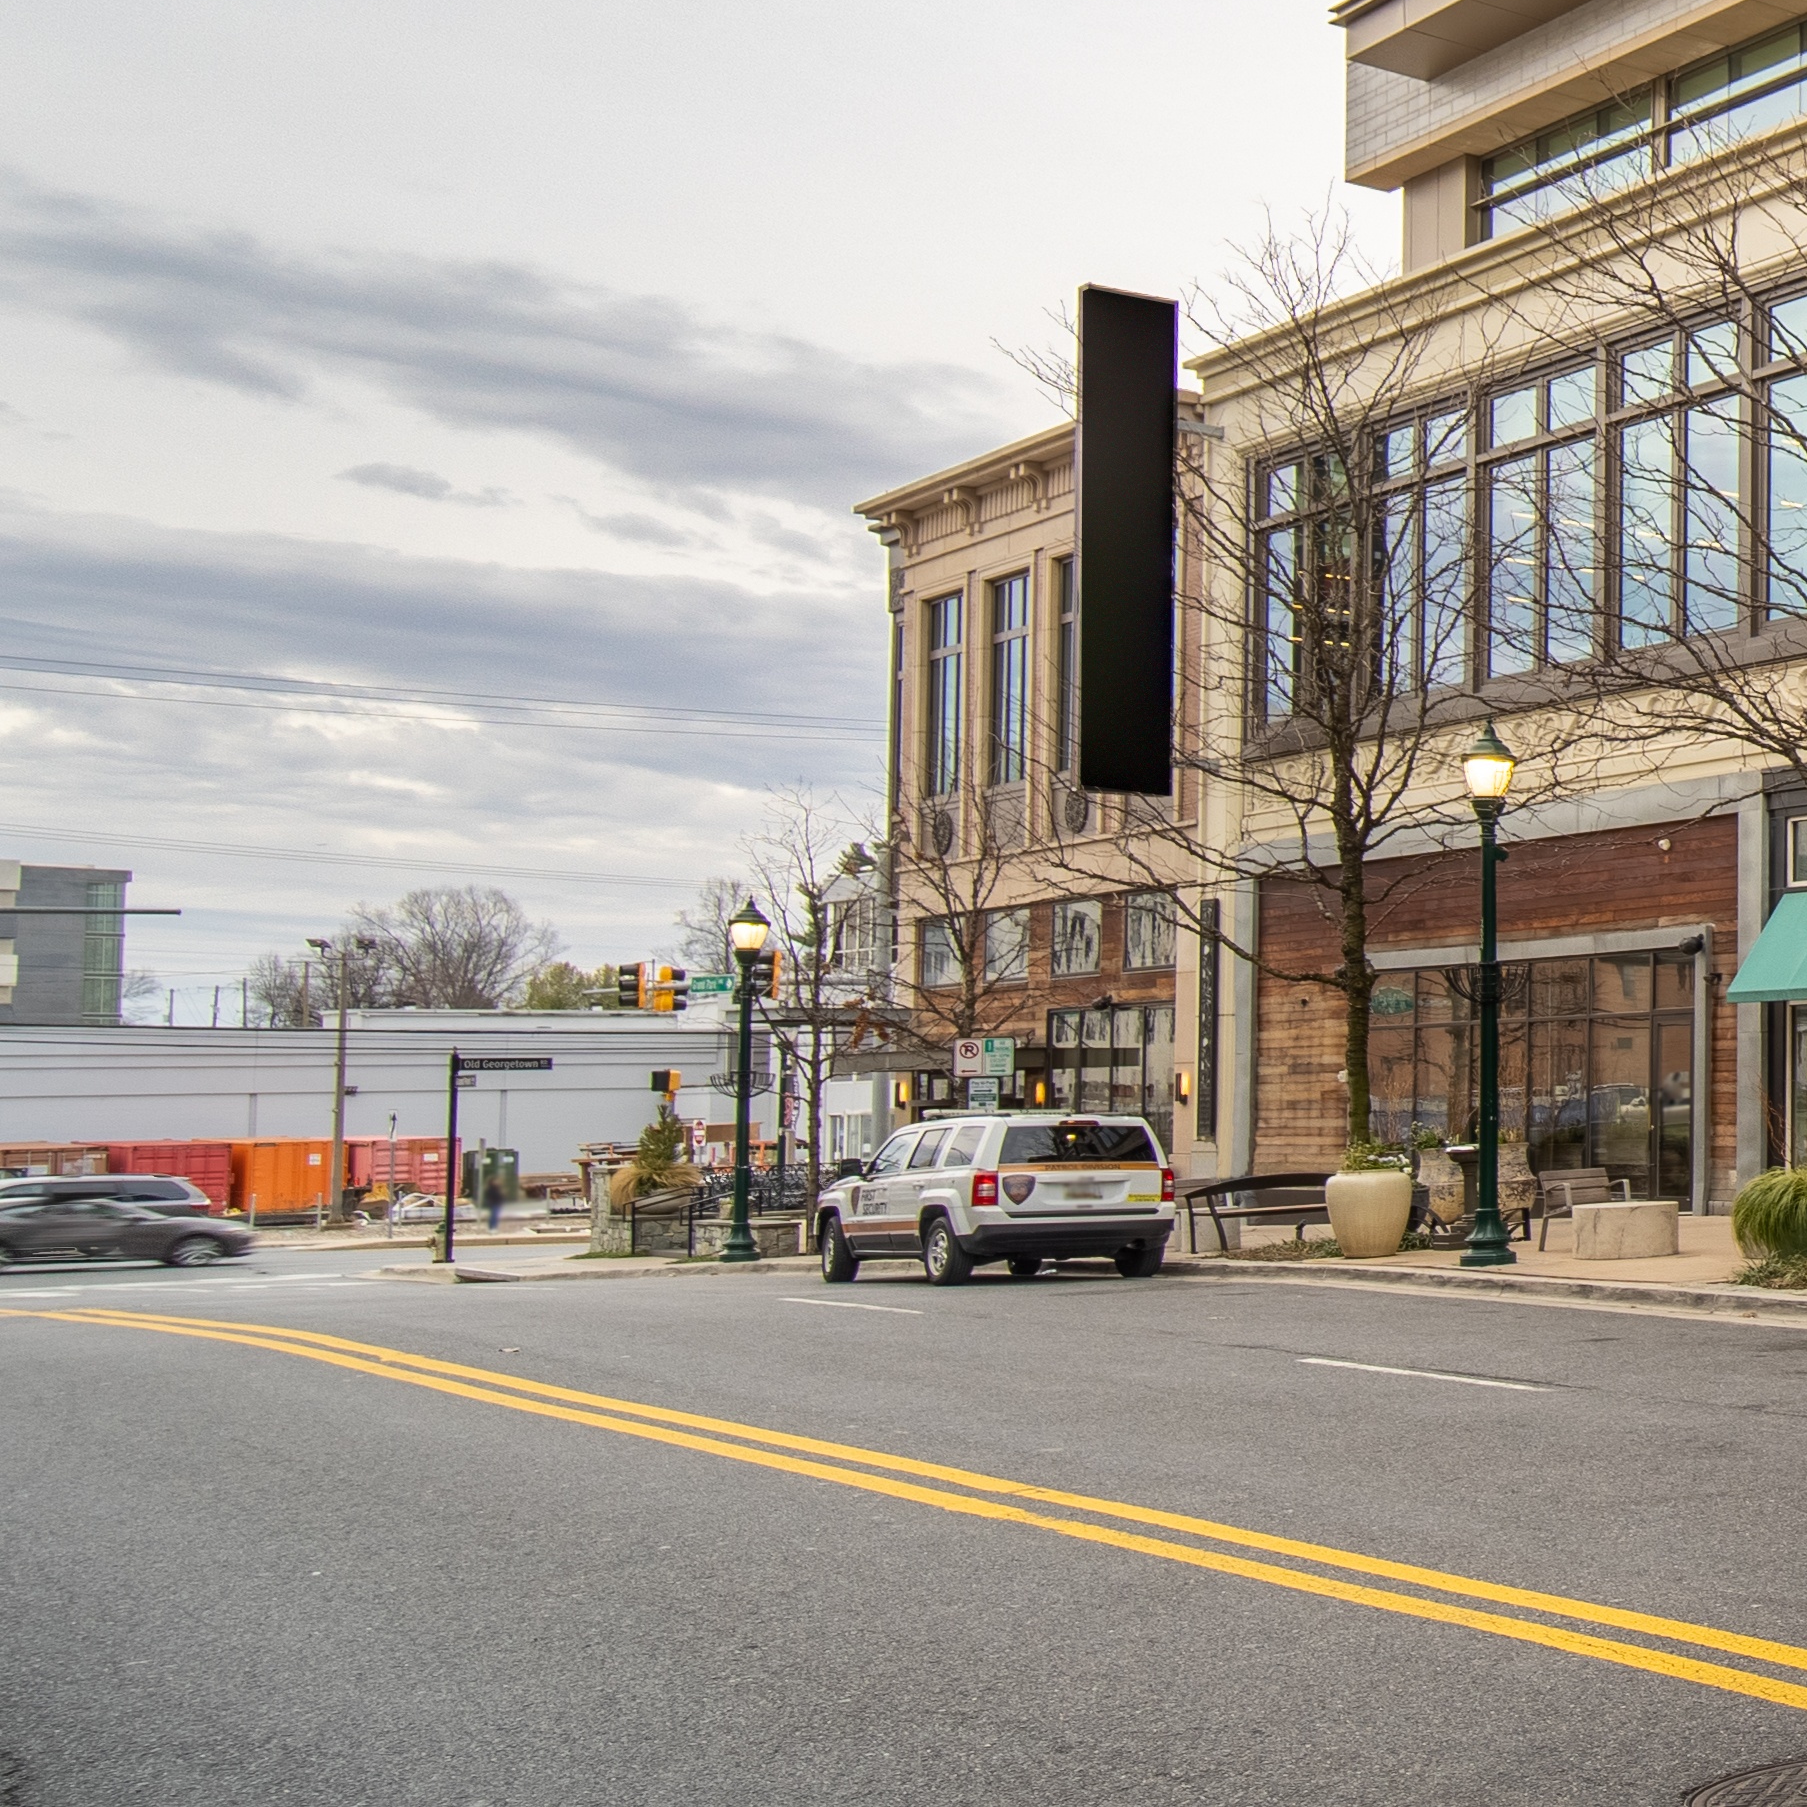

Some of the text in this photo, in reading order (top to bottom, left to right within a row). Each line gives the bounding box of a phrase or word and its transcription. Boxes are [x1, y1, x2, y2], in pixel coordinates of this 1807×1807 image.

[464, 1059, 481, 1069] Old
[482, 1059, 539, 1070] Georgetown
[1045, 1163, 1078, 1171] PATROL
